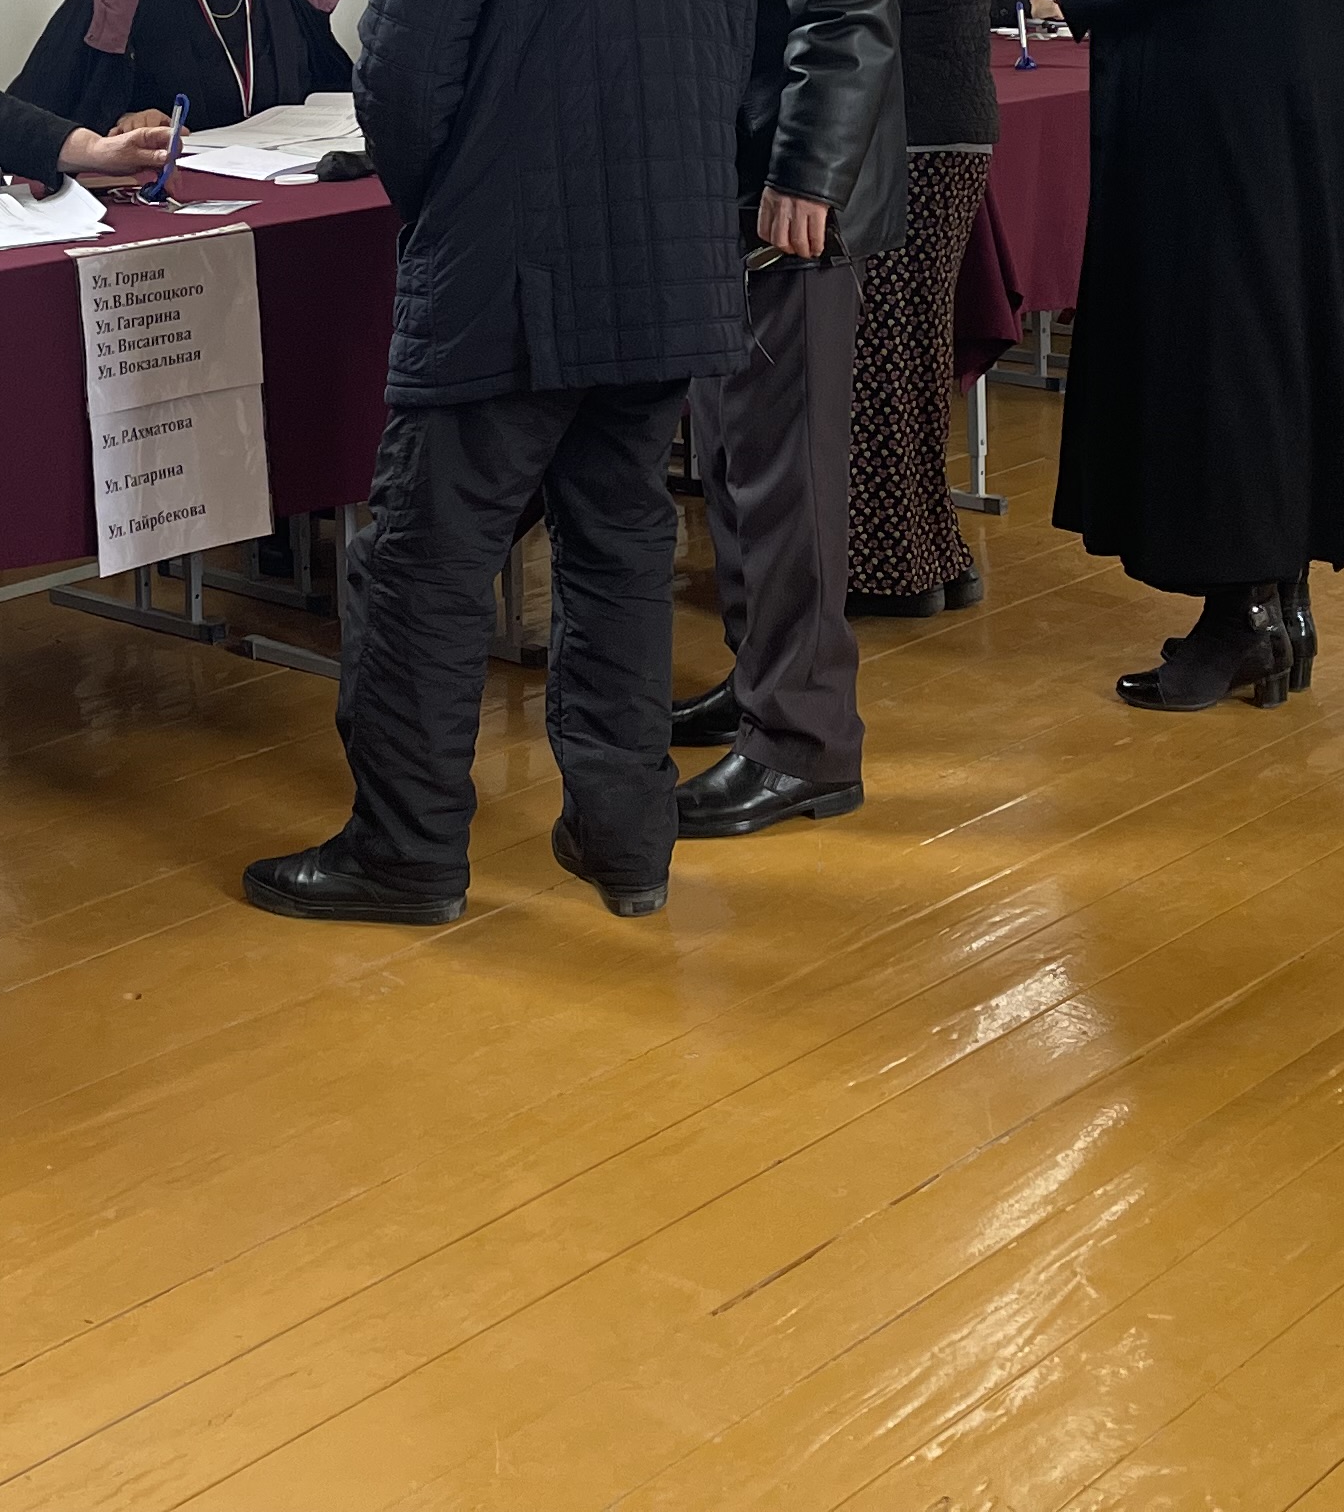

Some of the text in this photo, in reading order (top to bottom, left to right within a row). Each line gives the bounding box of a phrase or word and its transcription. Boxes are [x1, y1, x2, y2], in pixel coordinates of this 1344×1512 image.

[92, 268, 165, 290] Ул. Горная
[96, 309, 181, 335] Ул. Гагарина
[97, 342, 115, 358] Ул.
[98, 349, 201, 380] Ул. Вокзальная
[102, 417, 193, 449] Ул. Р.Ахматова
[105, 464, 184, 494] Ул. Гагарина
[108, 503, 207, 540] Ул. Гайрбекова
